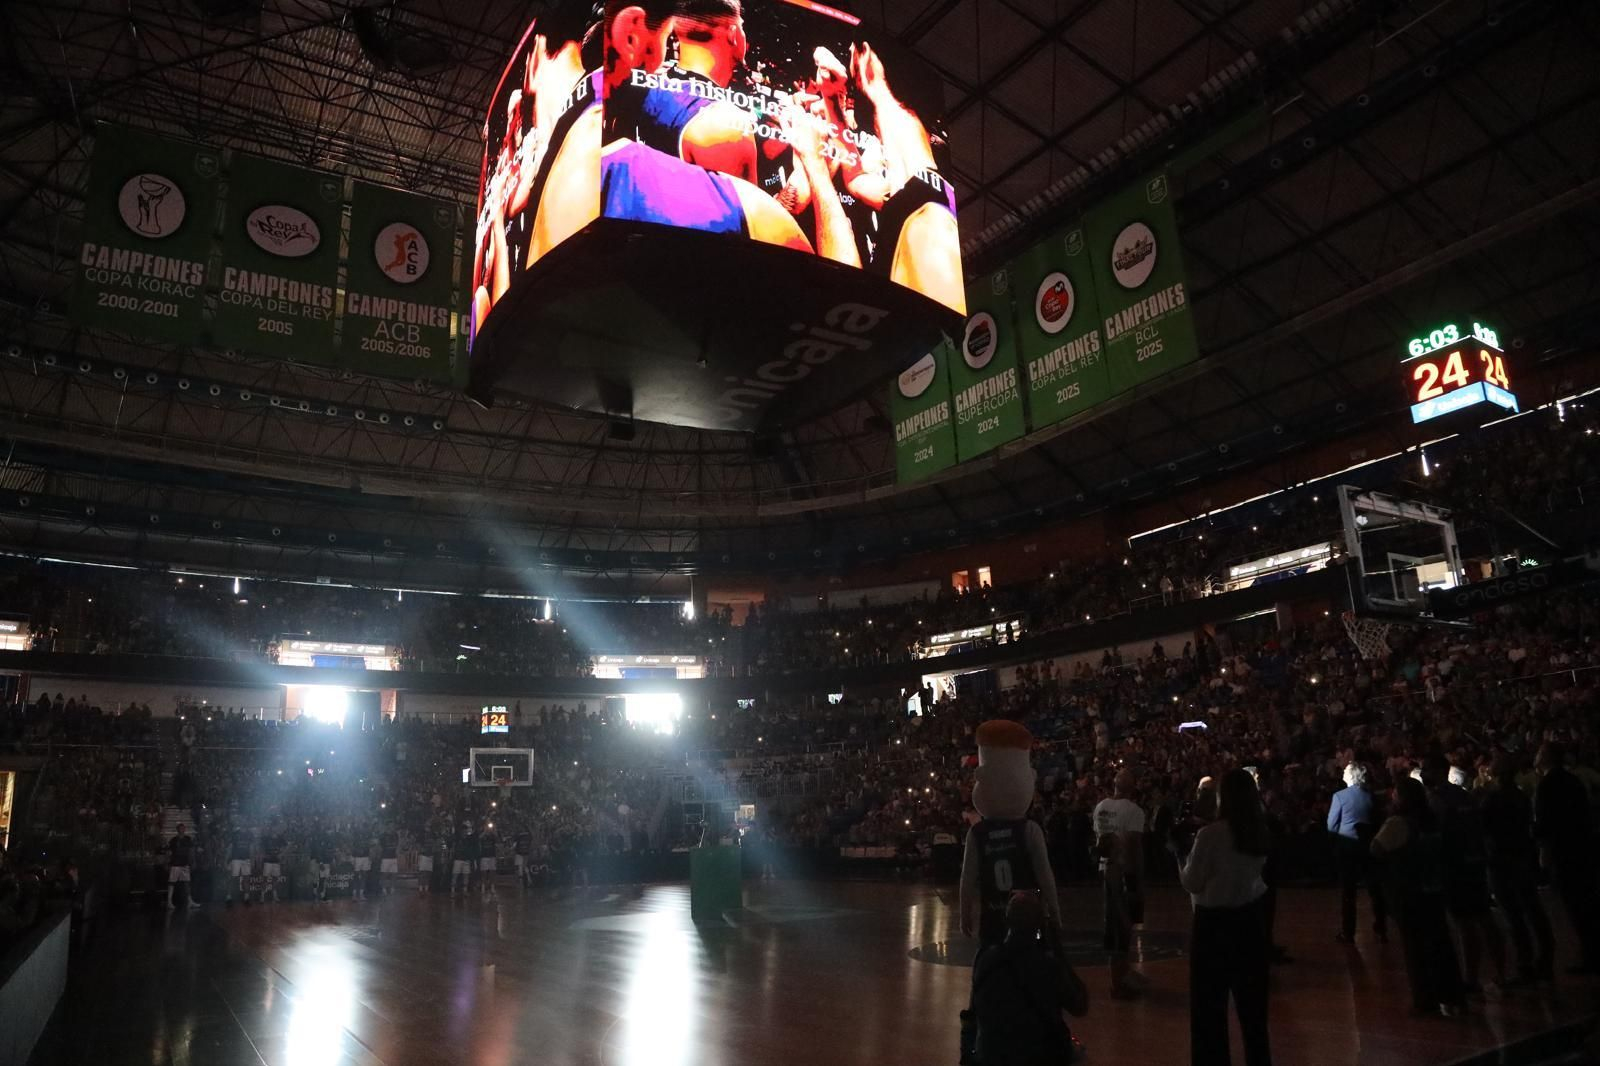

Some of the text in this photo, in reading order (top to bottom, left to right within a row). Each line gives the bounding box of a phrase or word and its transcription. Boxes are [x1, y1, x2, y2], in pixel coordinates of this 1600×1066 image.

[630, 68, 683, 93] Esta
[818, 141, 858, 167] 2025
[266, 215, 298, 232] Copa
[81, 242, 204, 286] CAMPEONES
[85, 267, 196, 299] COPA KORAC
[224, 266, 333, 309] CAMPEONES
[98, 292, 179, 318] 2000/2001
[220, 289, 333, 322] COPA DEL REY
[348, 292, 448, 329] CAMPEONES
[1105, 282, 1185, 340] CAMPEONES
[257, 317, 294, 336] 2005
[374, 319, 421, 344] ACB
[1135, 325, 1160, 346] BCL
[1408, 324, 1460, 358] 6:03
[361, 337, 432, 359] 2005/2006
[1028, 329, 1100, 383] CAMPEONES
[1136, 338, 1164, 362] 2025
[1031, 351, 1101, 392] COPA DEL REY
[1413, 351, 1470, 402] 24
[1480, 349, 1509, 391] 24
[955, 367, 1016, 413] CAMPEONES
[1056, 382, 1081, 404] 2025
[895, 401, 949, 442] CAMPEONES
[958, 388, 1019, 425] SUPERCOPA
[977, 415, 1000, 434] 2024
[914, 444, 934, 463] 2024
[1456, 573, 1549, 607] endesa
[490, 714, 506, 726] 24
